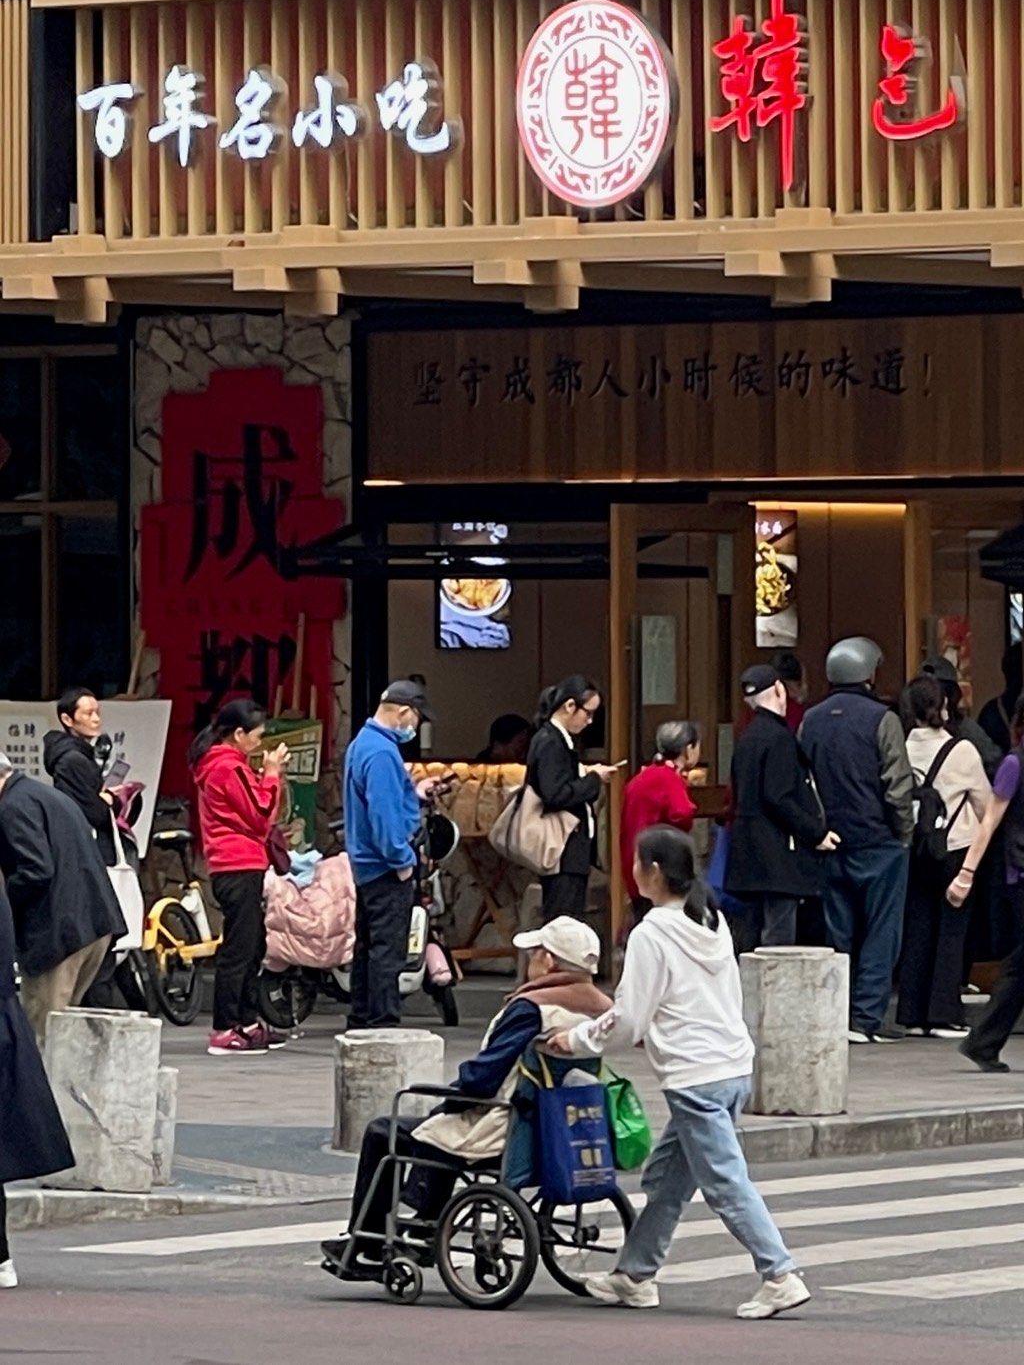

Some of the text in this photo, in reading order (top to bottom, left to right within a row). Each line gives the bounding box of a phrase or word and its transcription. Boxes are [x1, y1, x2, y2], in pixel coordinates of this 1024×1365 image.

[78, 63, 450, 167] 百年名小吃
